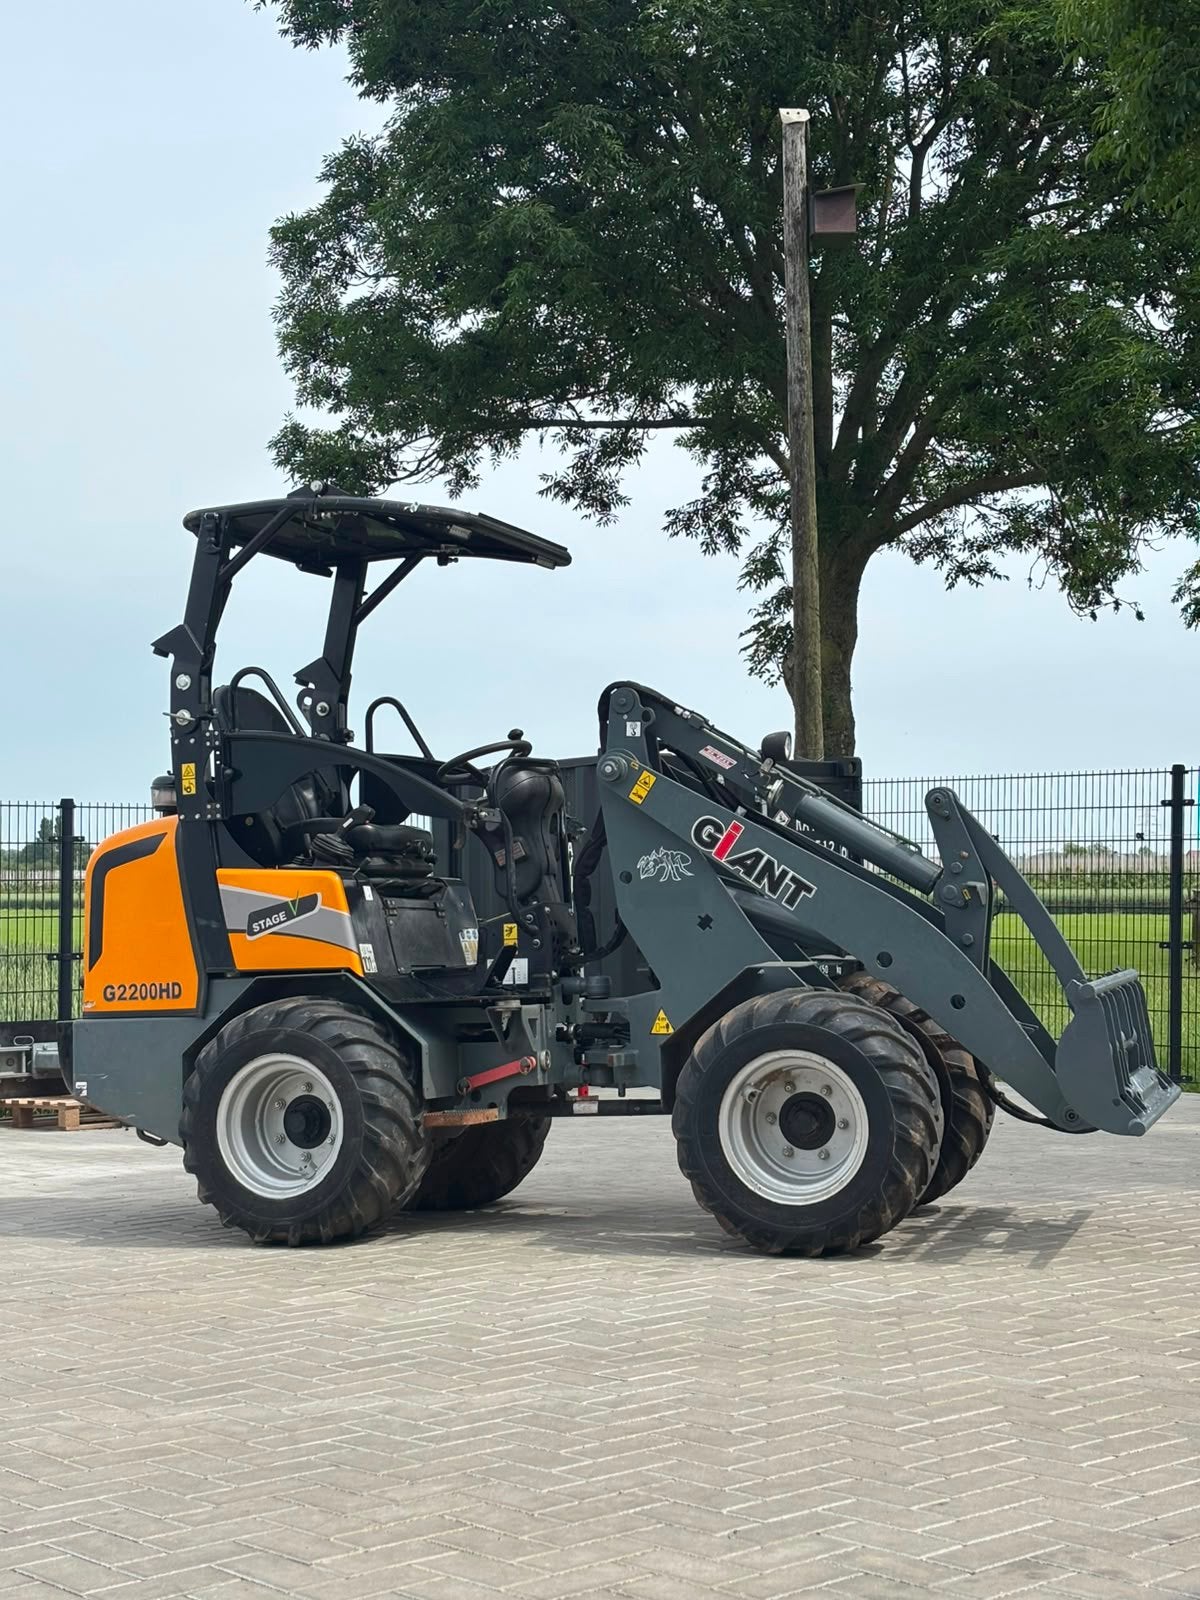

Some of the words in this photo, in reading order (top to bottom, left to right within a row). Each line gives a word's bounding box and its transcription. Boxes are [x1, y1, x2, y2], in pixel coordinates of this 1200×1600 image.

[252, 911, 287, 933] STAGE
[287, 890, 299, 917] V
[103, 981, 183, 1002] G2200HD
